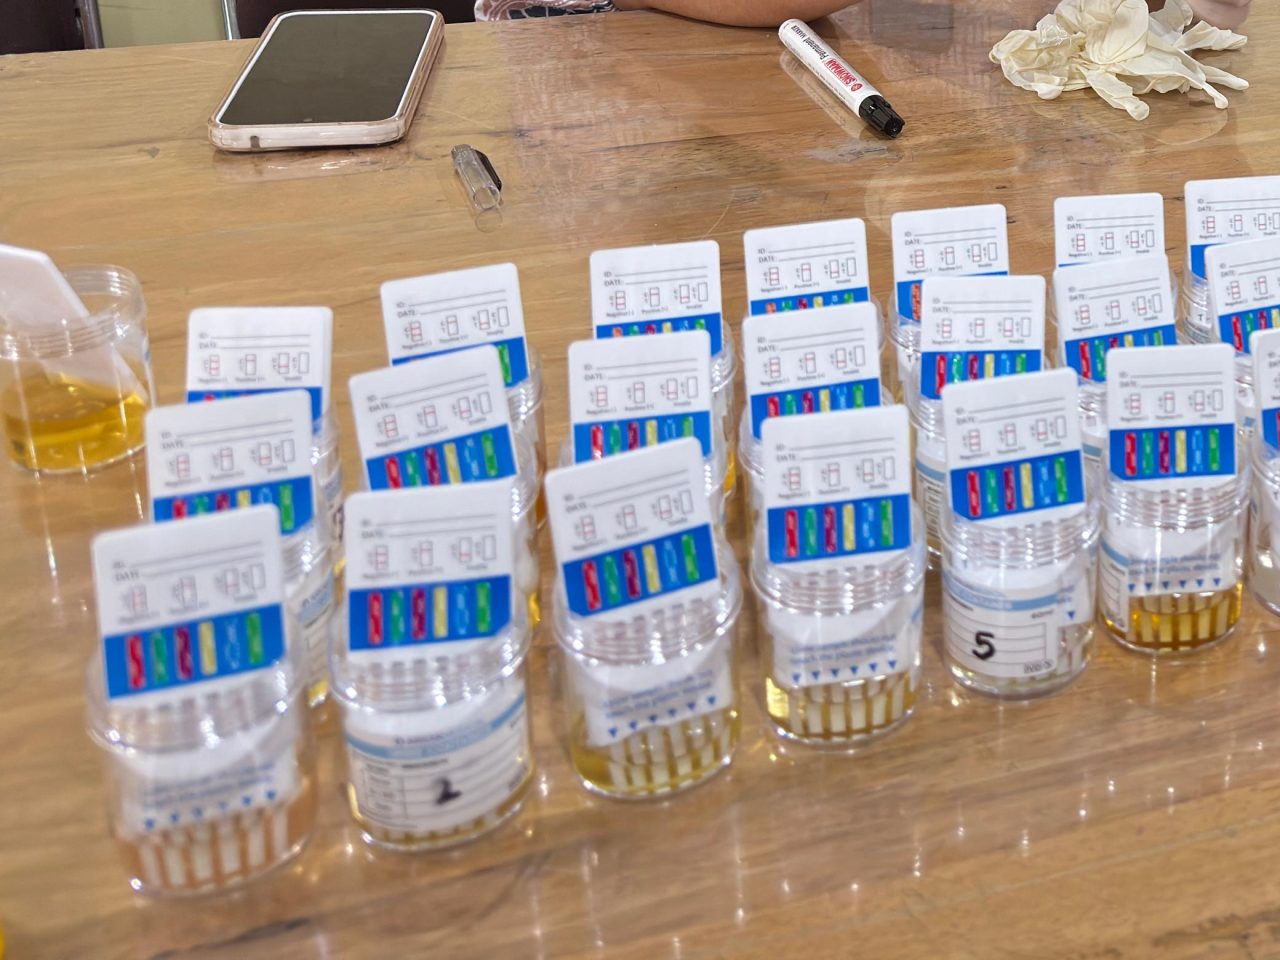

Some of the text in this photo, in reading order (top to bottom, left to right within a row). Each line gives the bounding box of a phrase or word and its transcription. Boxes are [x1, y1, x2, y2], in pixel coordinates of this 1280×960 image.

[1221, 269, 1237, 278] DATE:
[604, 278, 624, 286] DATE:
[1070, 292, 1088, 300] DATE:
[972, 630, 996, 661] 5
